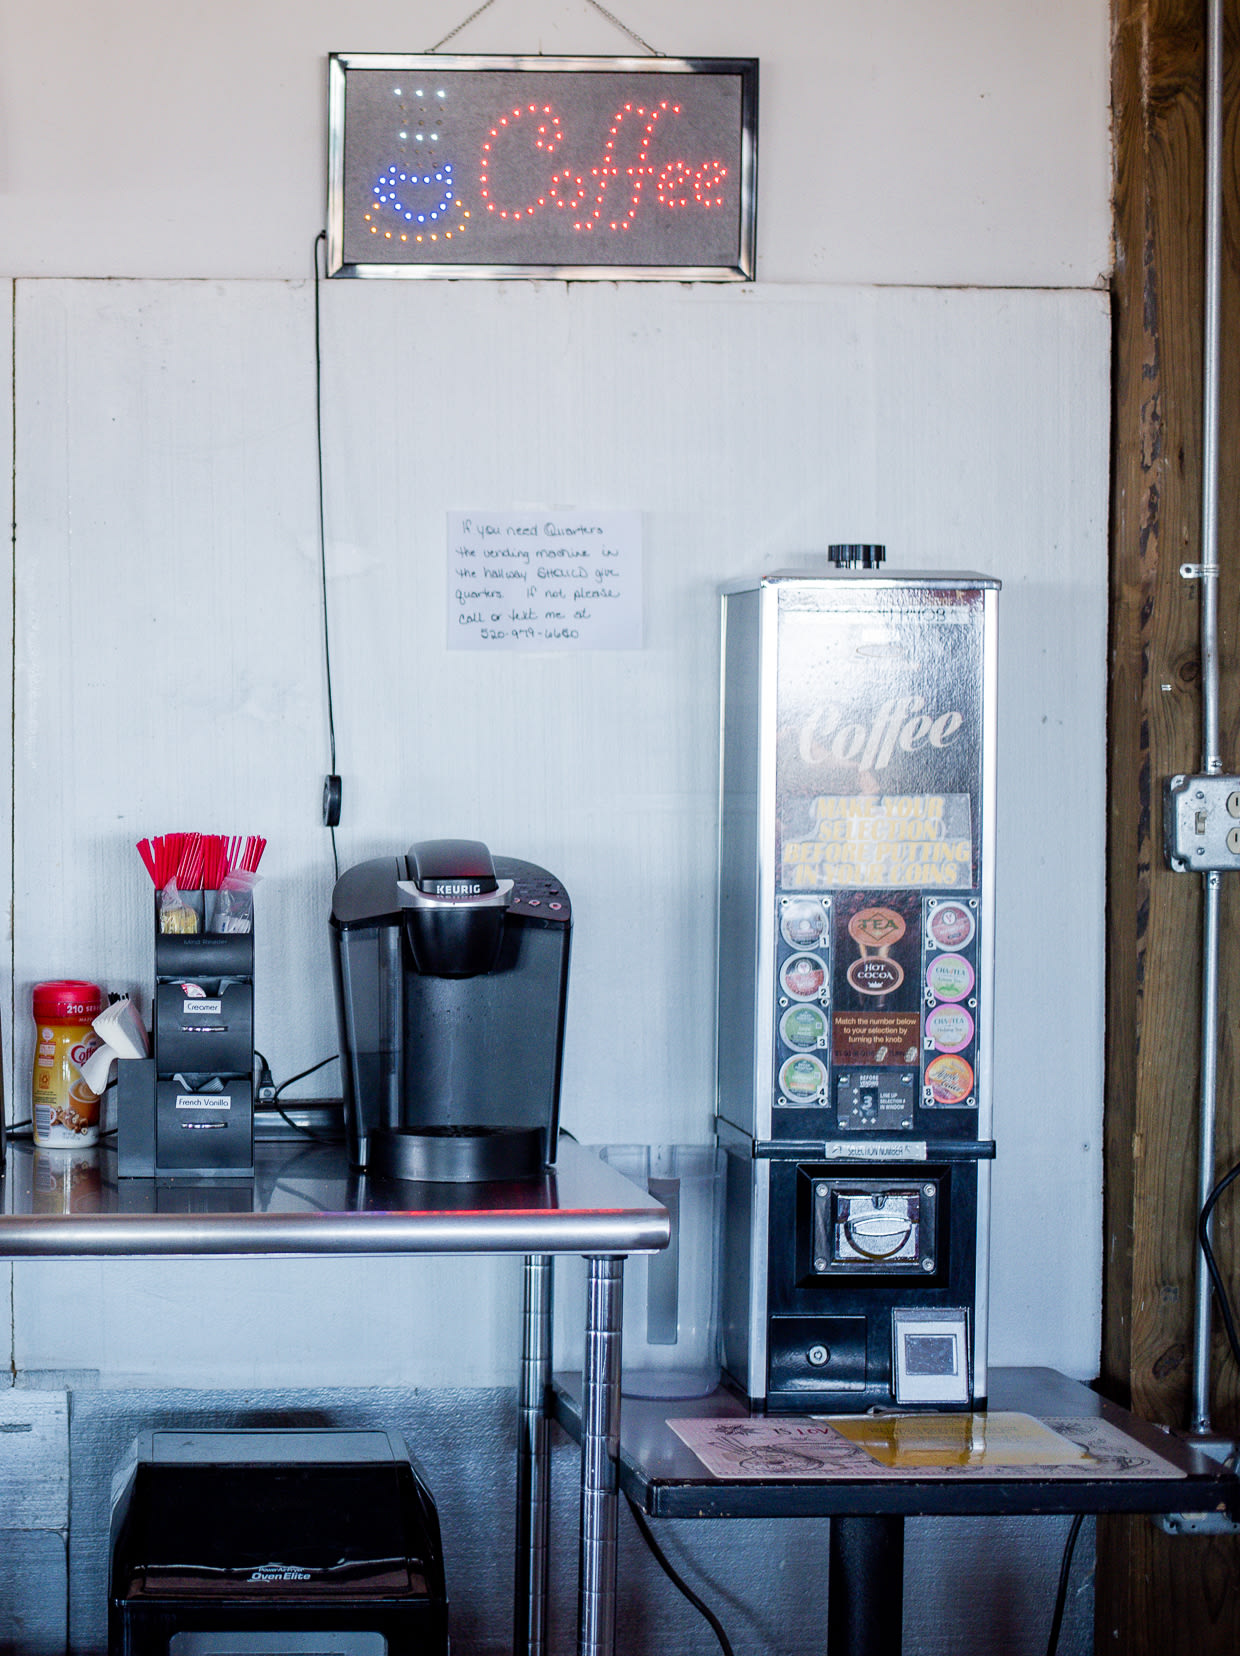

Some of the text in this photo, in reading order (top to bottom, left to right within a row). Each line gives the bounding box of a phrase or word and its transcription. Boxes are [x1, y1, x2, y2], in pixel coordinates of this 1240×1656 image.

[480, 102, 727, 230] Coffee
[477, 525, 500, 539] you
[507, 523, 538, 536] need
[544, 522, 603, 537] Quarters
[456, 546, 476, 558] the
[484, 548, 530, 564] vending
[536, 548, 590, 559] machine
[456, 567, 619, 583] the hallway SHOULD give
[545, 588, 566, 599] not
[574, 588, 620, 601] please
[491, 614, 502, 622] or
[509, 608, 538, 620] text
[574, 608, 591, 619] at
[800, 696, 965, 771] Coffee
[816, 796, 943, 818] MAKE YOUR
[818, 820, 939, 841] SELECTION
[784, 841, 970, 863] BEFORE PUTTING
[795, 864, 958, 885] IN YOUR COINS
[436, 884, 481, 895] KEURIG
[858, 919, 899, 930] TEA
[864, 963, 886, 972] HOT
[858, 972, 894, 980] COCOA
[67, 1005, 84, 1014] 210
[187, 1003, 218, 1012] Creamer
[899, 1027, 908, 1036] by
[848, 1036, 872, 1044] turning
